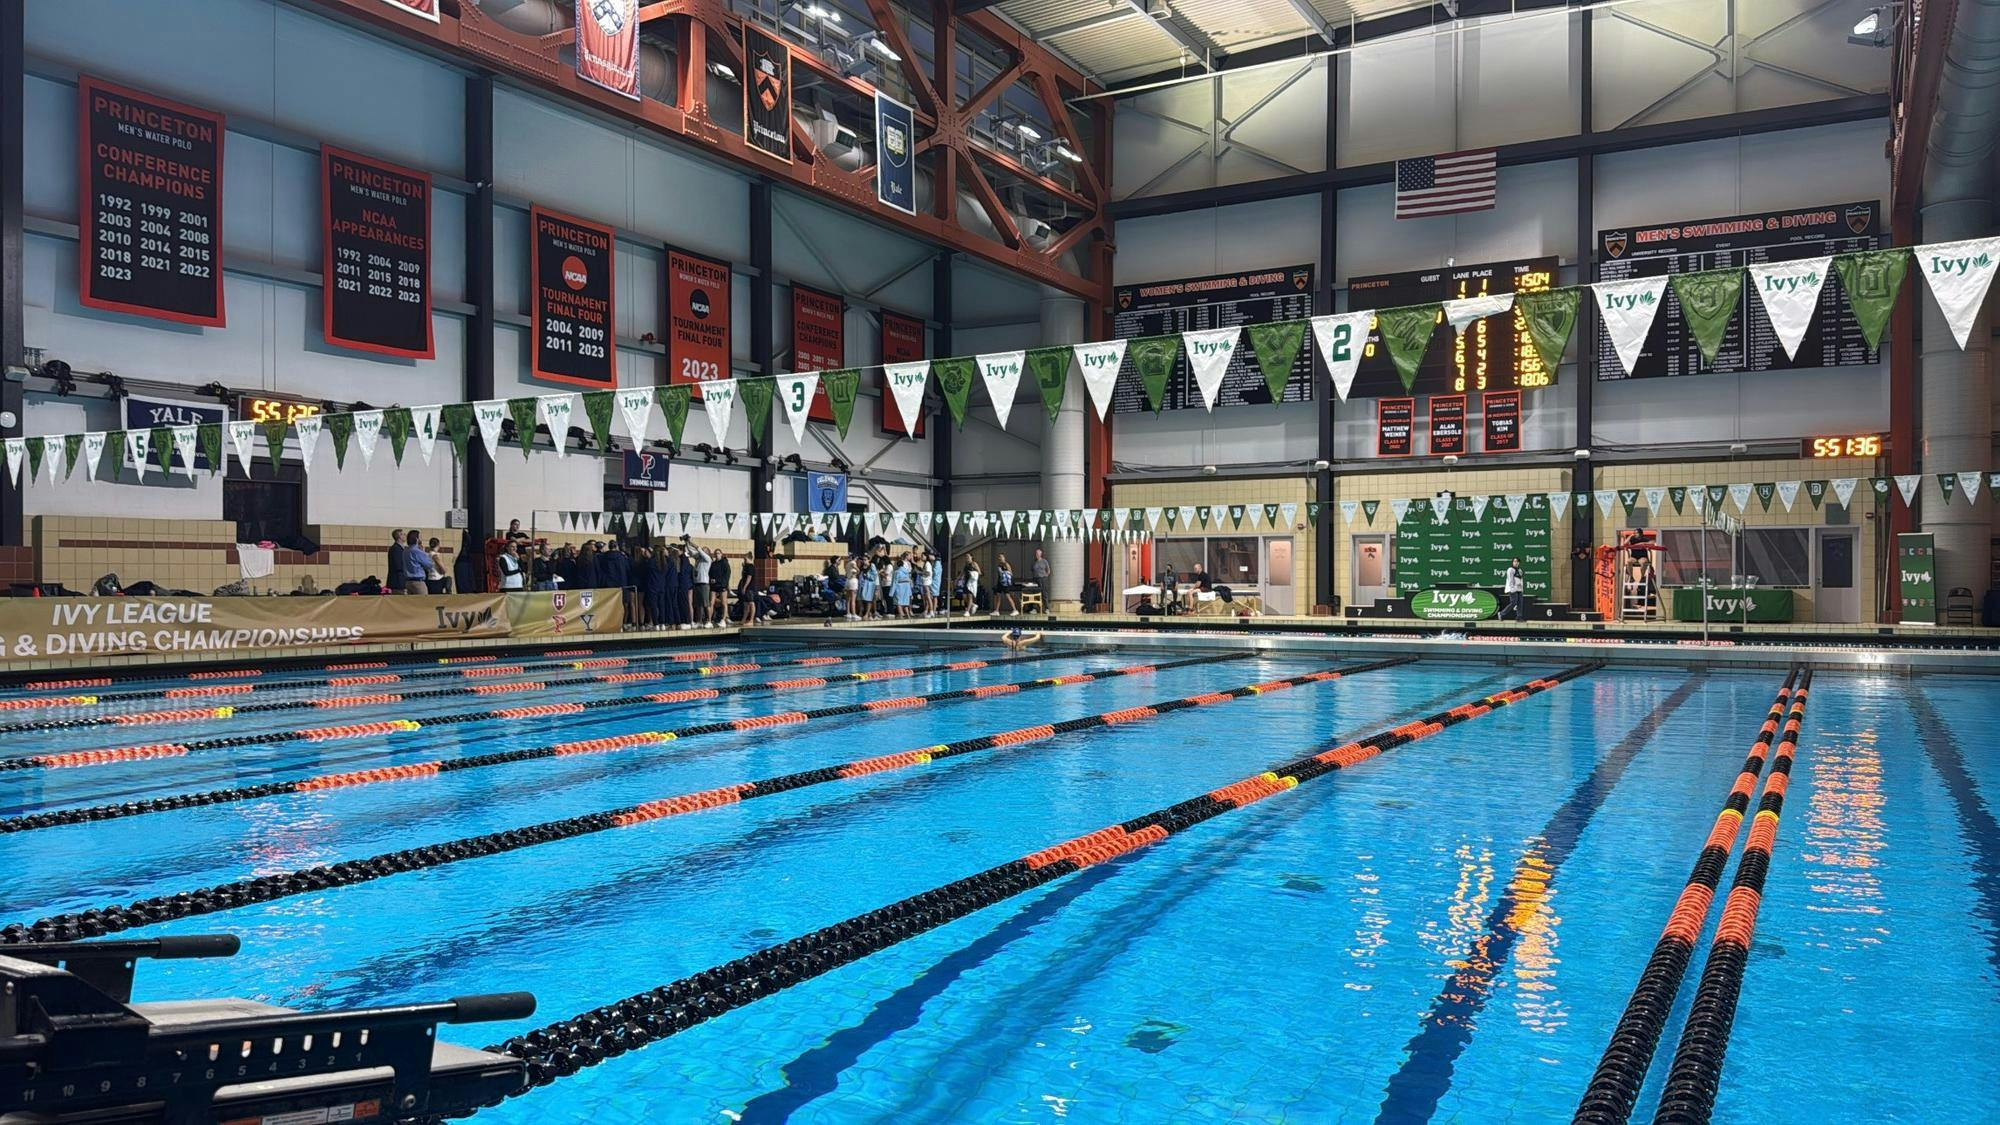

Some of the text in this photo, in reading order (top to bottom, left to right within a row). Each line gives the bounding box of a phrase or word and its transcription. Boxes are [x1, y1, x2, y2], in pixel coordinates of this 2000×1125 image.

[94, 96, 212, 143] PRINCETON
[118, 123, 192, 151] MEN'S WATER POLO
[97, 143, 211, 184] CONFERENCE
[103, 163, 205, 200] CHAMPIONS
[333, 161, 423, 199] PRINCETON
[350, 185, 407, 206] MEN'S WATER POLO
[100, 194, 208, 228] 1992 1999 2001
[362, 209, 397, 229] NCAA
[99, 211, 210, 245] 2003 2004 2008
[332, 218, 424, 250] APPEARANCES
[540, 220, 607, 250] PRINCETON
[1635, 211, 1837, 243] MEN'S SWIMMING & DIVING
[99, 229, 210, 261] 2010 2014 2015
[100, 247, 210, 279] 2018 2021 2022
[337, 247, 420, 274] 1992 2004 2009
[671, 256, 727, 282] PRINCETON
[1931, 256, 1970, 276] Ivy
[100, 264, 132, 281] 2023
[336, 262, 420, 289] 2011 2015 2018
[564, 270, 587, 284] NCAA
[1420, 274, 1440, 283] GUEST
[1452, 265, 1530, 280] LANE PLACE TIME
[337, 277, 420, 304] 2021 2022 2023
[1140, 272, 1285, 297] WOMEN'S SWIMMING & DIVING
[1351, 280, 1390, 290] PRINCETON
[1460, 281, 1466, 293] 1
[1482, 279, 1488, 290] 1
[1764, 275, 1800, 294] Ivy
[542, 286, 607, 312] TOURNAMENT
[691, 302, 710, 314] NCAA
[796, 292, 840, 313] PRINCETON
[1605, 293, 1638, 310] Ivy
[547, 302, 603, 324] FINAL FOUR
[546, 318, 604, 342] 2004 2009
[673, 316, 726, 337] TOURNAMENT
[1476, 320, 1486, 333] 6
[546, 335, 605, 359] 2011 2023
[678, 330, 722, 349] FINAL FOUR
[1193, 340, 1219, 357] Ivy
[1332, 323, 1352, 362] 2
[1455, 334, 1486, 349] 5 5
[1084, 353, 1107, 369] Ivy
[1455, 349, 1487, 363] 6 4
[682, 357, 719, 380] 2023
[986, 363, 1008, 379] Ivy
[1456, 362, 1487, 377] 7 2
[893, 372, 915, 388] Ivy
[1455, 377, 1465, 391] 8
[1477, 376, 1486, 389] 3
[624, 397, 639, 410] Ivy
[705, 390, 723, 404] Ivy
[792, 381, 805, 413] 3
[149, 407, 203, 426] YALE
[481, 409, 495, 421] Ivy
[547, 403, 560, 416] Ivy
[424, 413, 433, 439] 4
[136, 435, 145, 458] 5
[1621, 492, 1636, 506] Y
[1901, 570, 1920, 585] Ivy
[1432, 590, 1460, 606] Ivy
[1706, 595, 1738, 614] Ivy
[52, 602, 213, 626] IVY LEAGUE
[435, 606, 475, 634] Ivy
[1546, 609, 1553, 617] 6
[1580, 613, 1587, 621] 8
[580, 614, 594, 631] Y
[14, 634, 38, 656] &
[46, 630, 148, 655] DIVING
[153, 626, 365, 651] CHAMPIONSHIPS
[298, 1058, 307, 1069] 3
[327, 1055, 336, 1066] 2
[355, 1052, 362, 1062] 1
[205, 1068, 215, 1080] 6
[238, 1064, 247, 1077] 5
[268, 1061, 278, 1073] 4
[101, 1080, 111, 1092] 9
[136, 1076, 147, 1088] 8
[172, 1072, 183, 1084] 7
[23, 1089, 36, 1101] 11
[62, 1084, 75, 1097] 10
